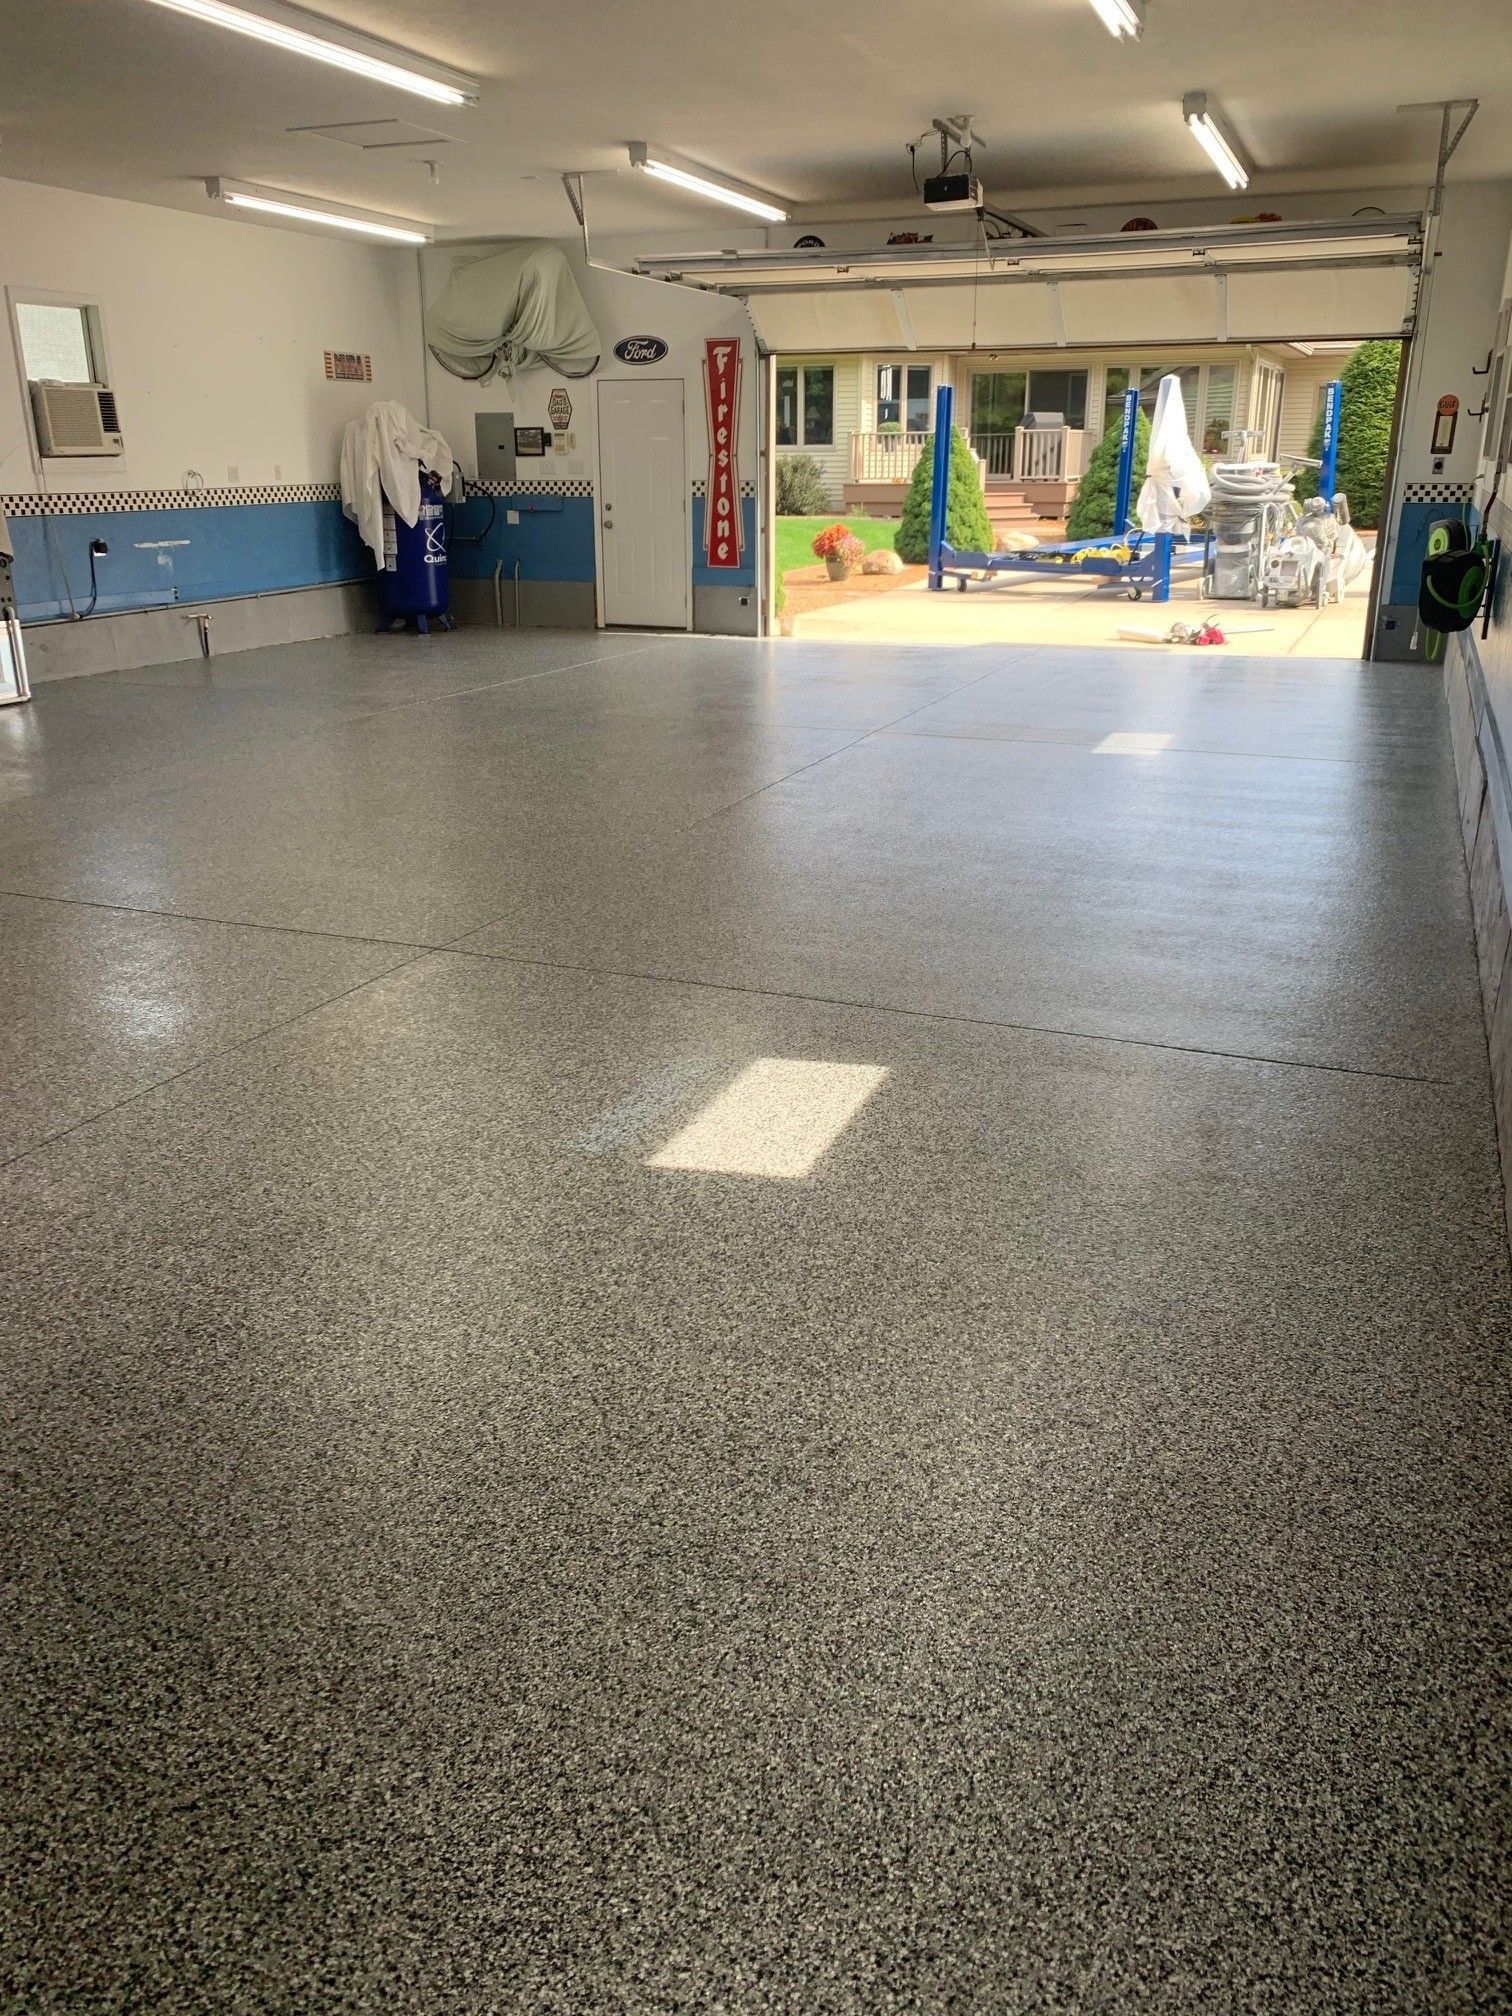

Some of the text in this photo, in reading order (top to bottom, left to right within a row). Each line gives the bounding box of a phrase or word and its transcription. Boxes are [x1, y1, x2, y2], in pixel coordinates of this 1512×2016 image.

[624, 340, 657, 360] Ford
[550, 405, 570, 415] GARAGE
[1122, 394, 1132, 441] BENDPAK
[1324, 387, 1335, 439] BENDPAK
[712, 346, 732, 560] Firestone
